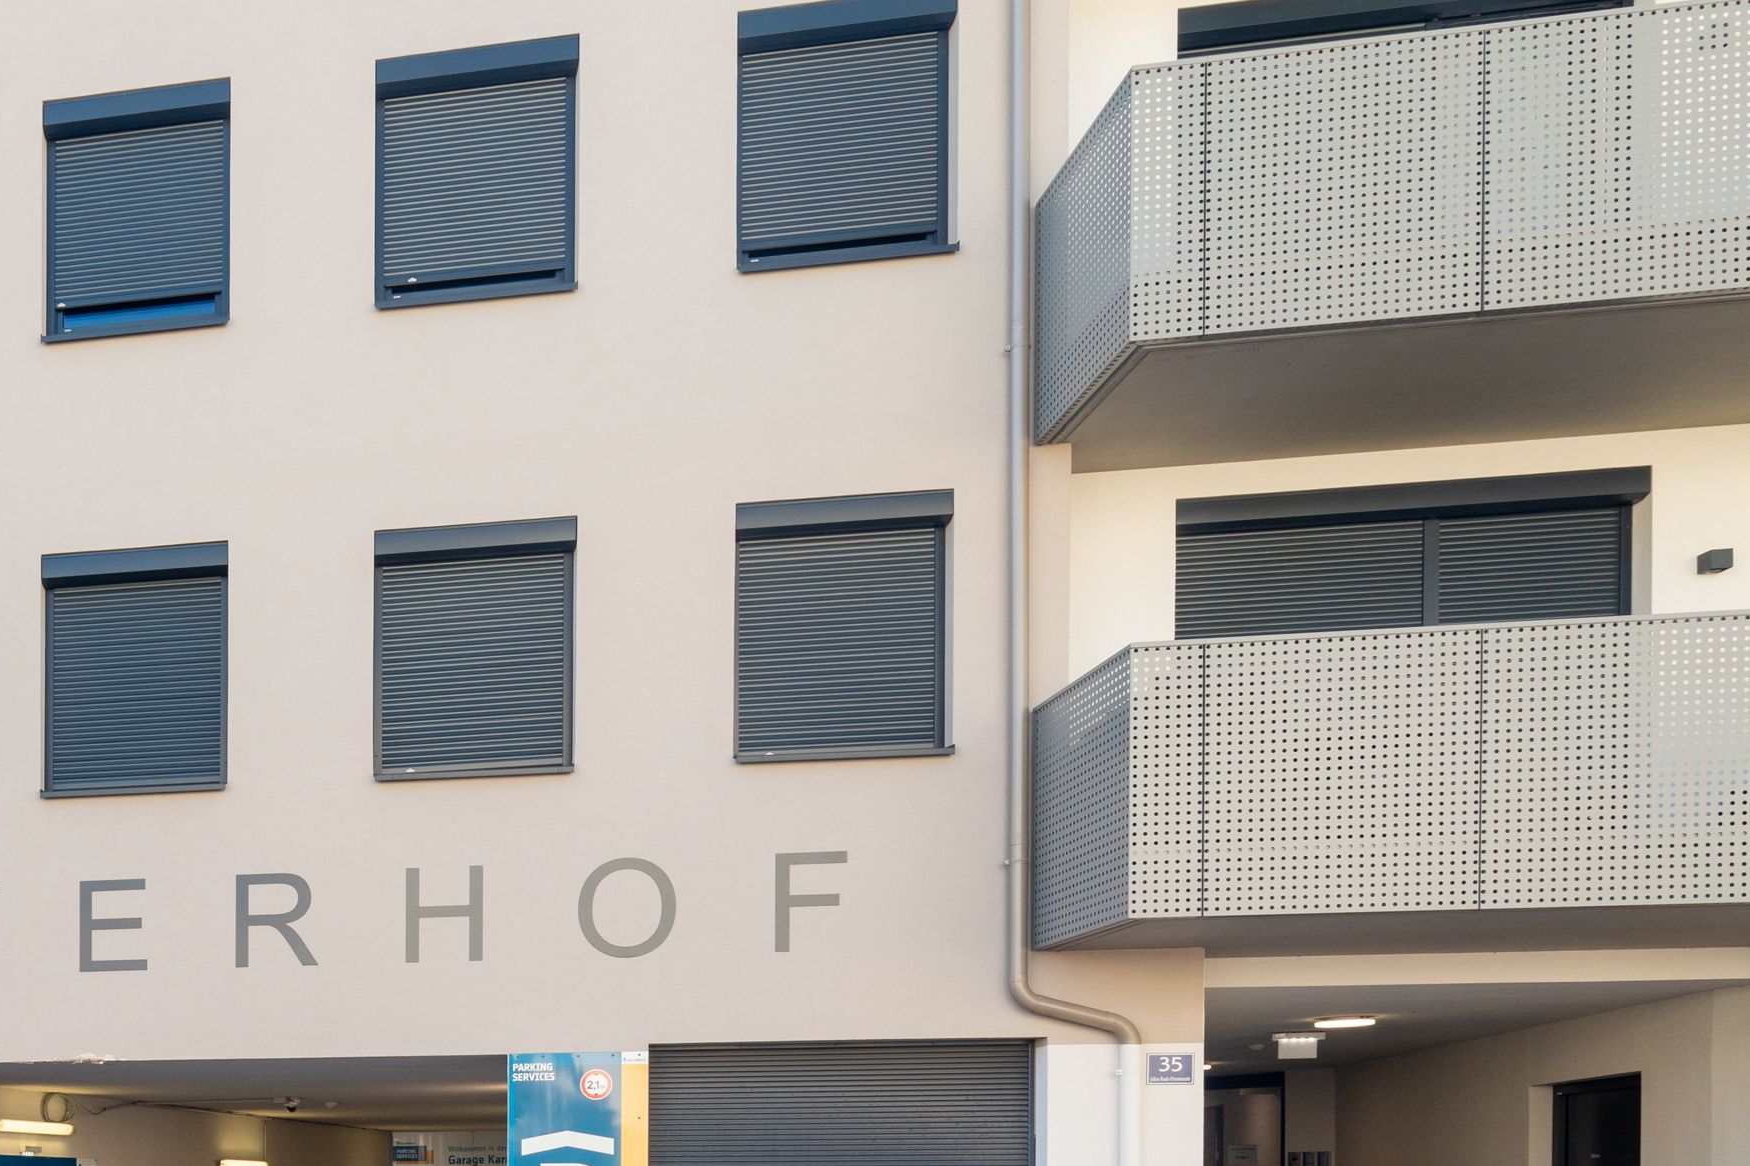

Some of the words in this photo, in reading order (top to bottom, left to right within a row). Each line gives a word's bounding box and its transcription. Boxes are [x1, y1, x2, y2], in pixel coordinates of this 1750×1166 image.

[512, 1063, 553, 1071] PARKING
[1159, 1056, 1183, 1072] 35
[512, 1072, 555, 1082] SERVICES
[448, 1155, 485, 1166] Garage
[488, 1155, 507, 1164] Kar
